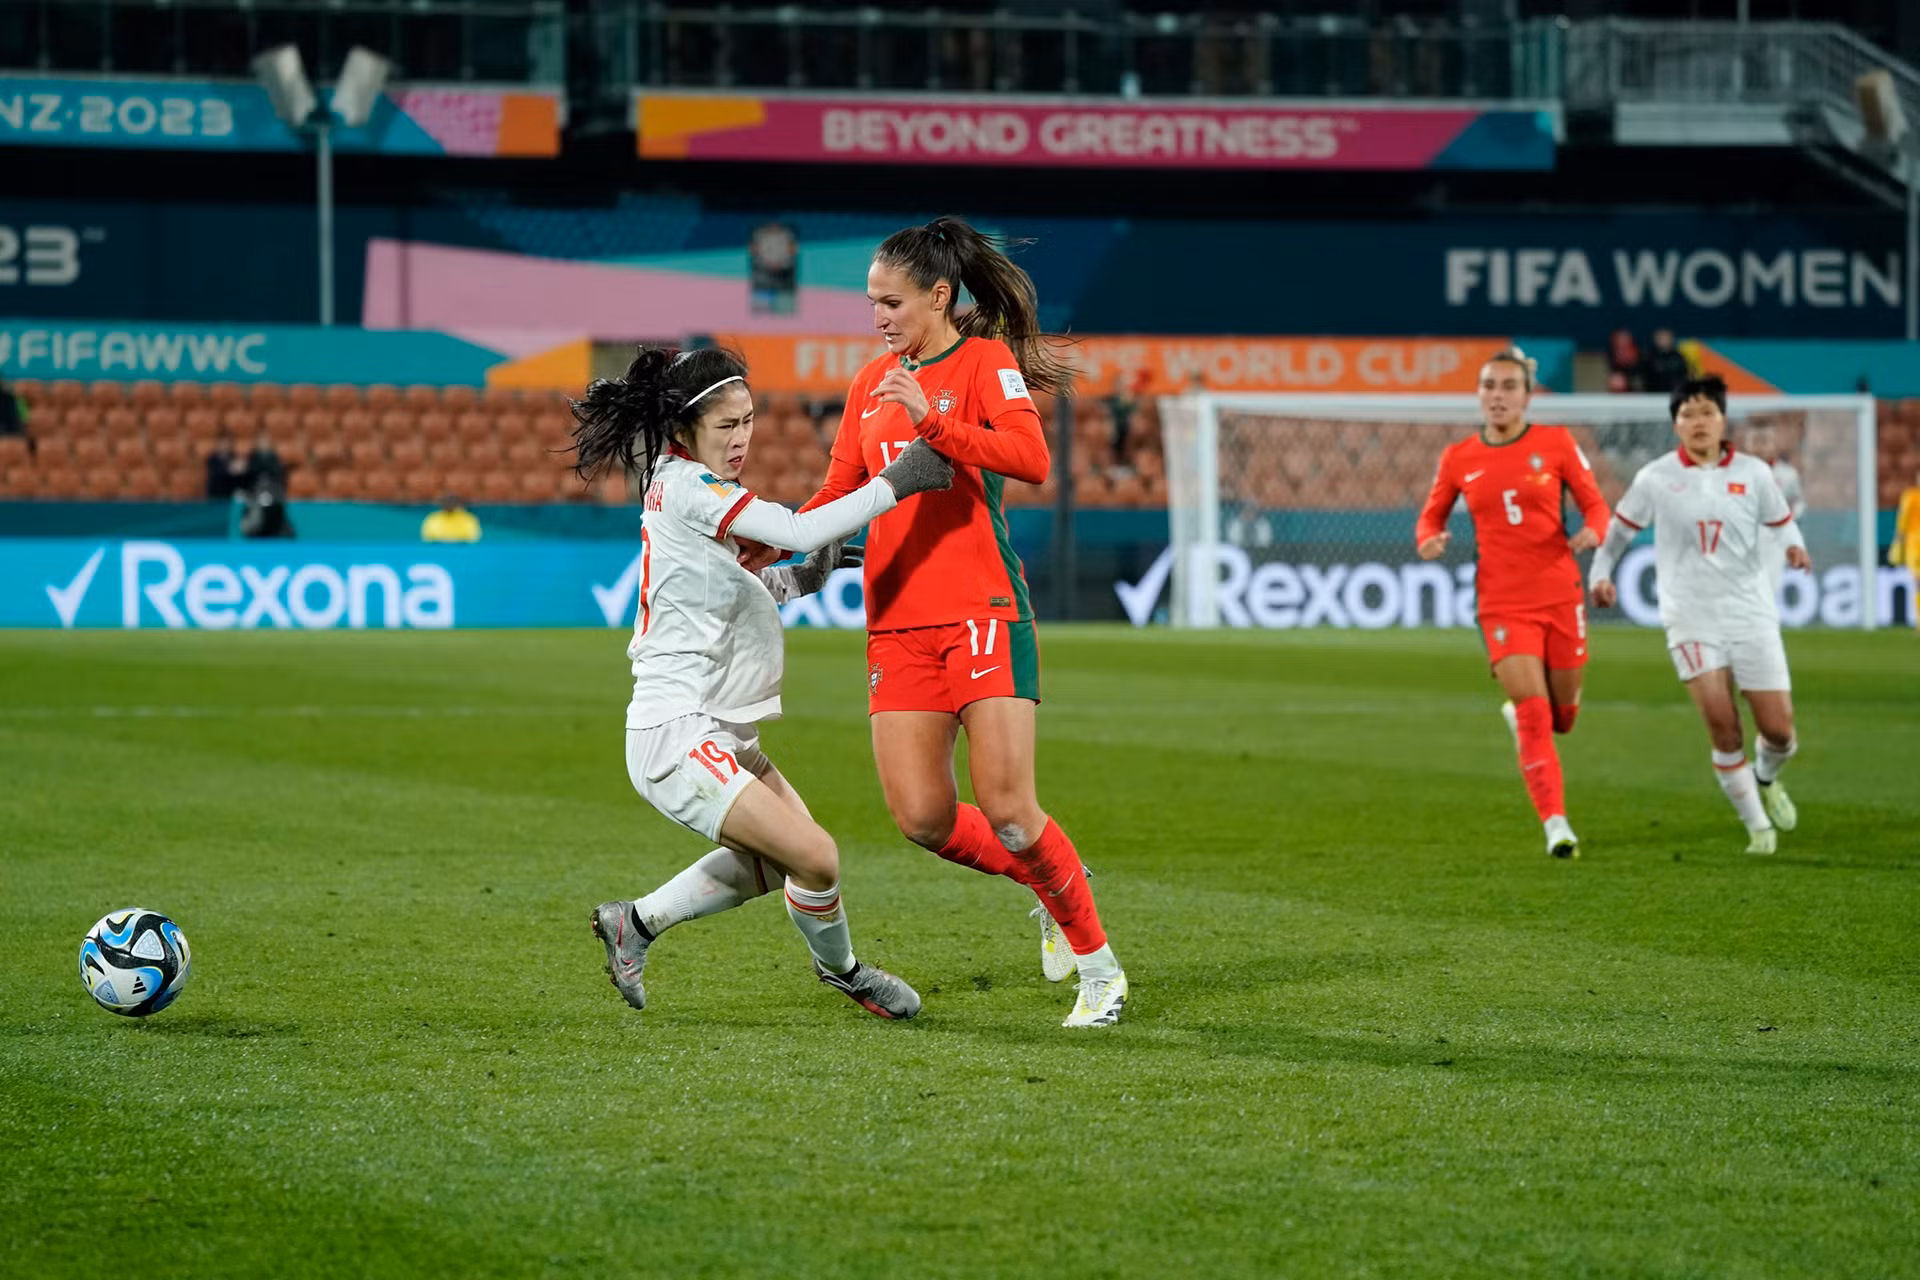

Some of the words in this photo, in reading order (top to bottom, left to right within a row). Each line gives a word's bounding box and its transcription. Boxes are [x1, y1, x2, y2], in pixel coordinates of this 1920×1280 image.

[823, 108, 1030, 155] BEYOND
[1445, 249, 1601, 306] FIFA
[1613, 250, 1900, 308] WOMEN
[794, 341, 888, 379] FIF
[1160, 342, 1344, 385] WORLD
[1356, 344, 1460, 386] CUP
[1503, 489, 1523, 526] 5
[1698, 520, 1722, 554] 17
[122, 540, 455, 628] Rexona
[688, 740, 739, 785] 19
